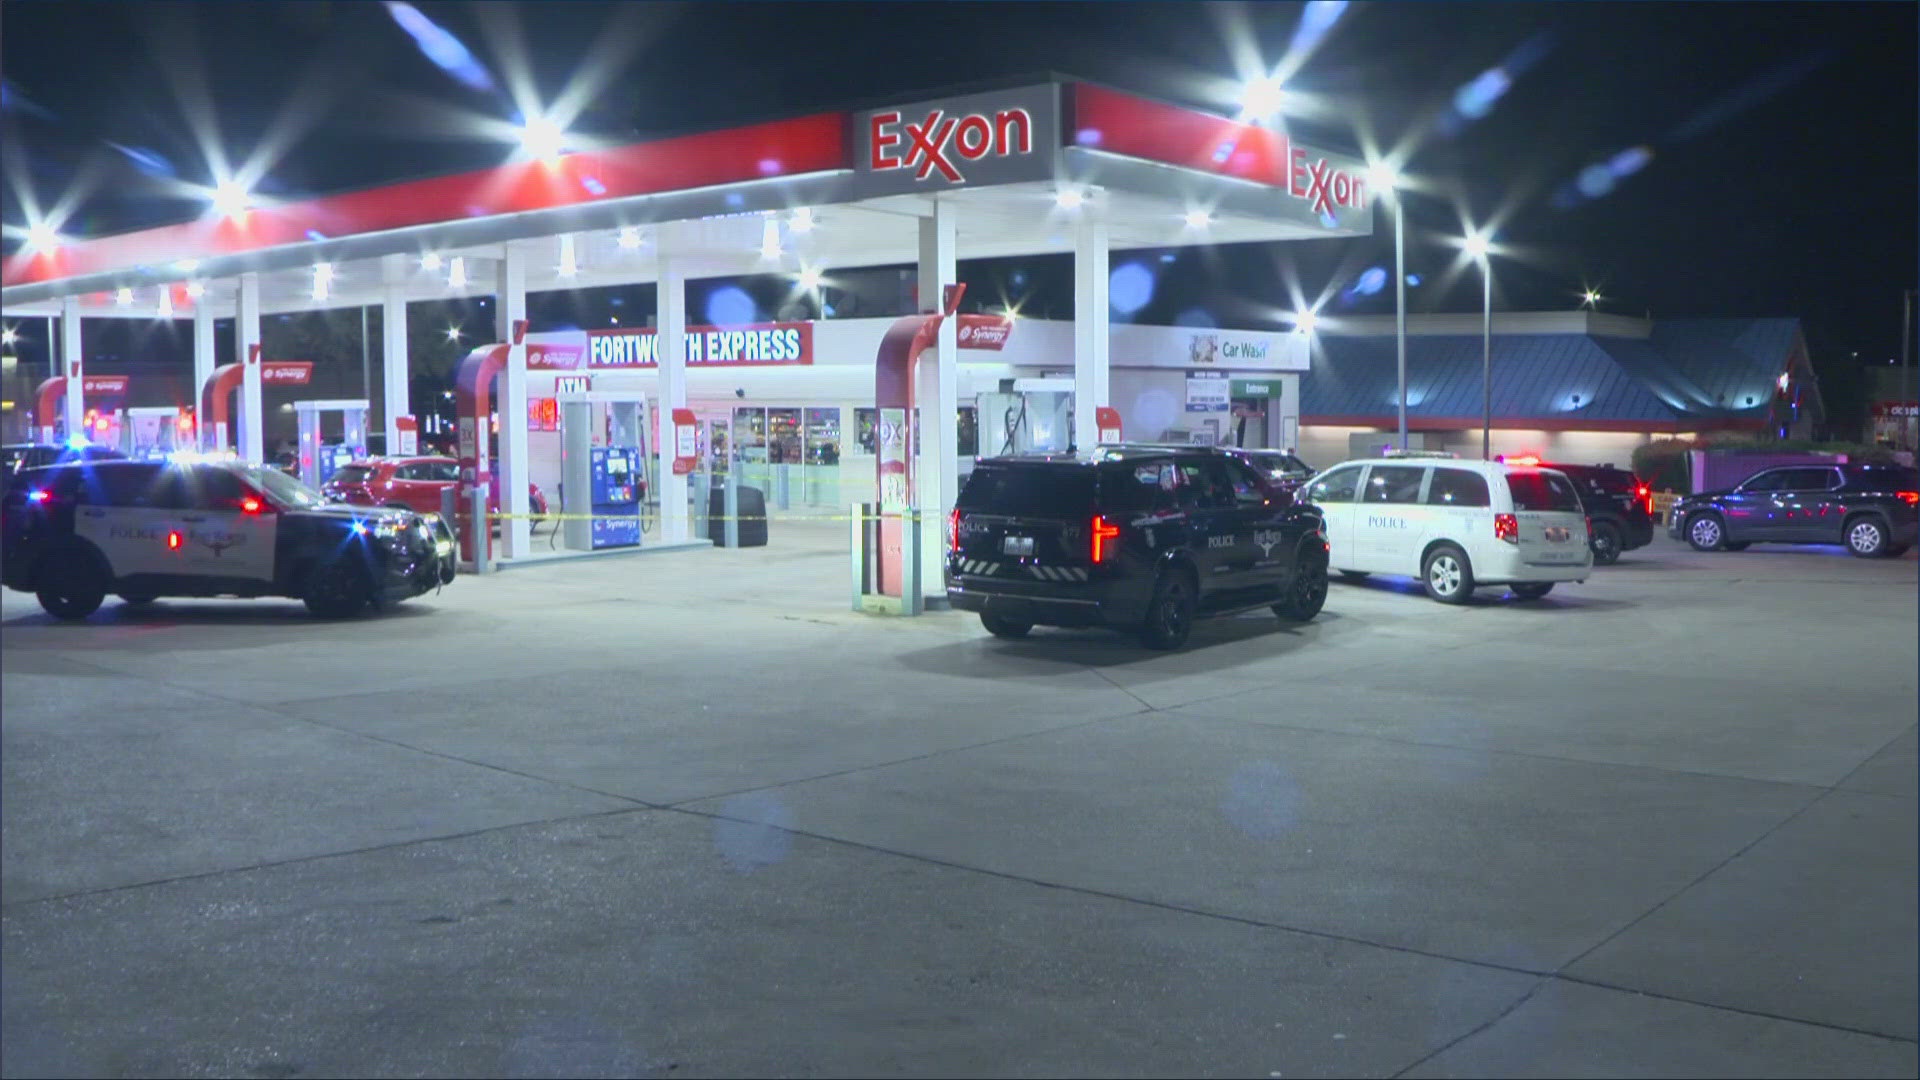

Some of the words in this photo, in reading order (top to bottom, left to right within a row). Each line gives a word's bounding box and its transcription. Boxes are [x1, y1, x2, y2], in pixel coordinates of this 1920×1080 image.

[870, 108, 1032, 184] Exxon
[1288, 148, 1366, 220] Exxon
[972, 328, 1006, 343] Synergy
[706, 329, 800, 361] EXPRESS
[1222, 342, 1239, 357] Car
[1241, 342, 1266, 359] Wash
[557, 377, 587, 393] ATM
[606, 519, 637, 531] Synergy
[1368, 515, 1408, 529] POLICE
[1208, 534, 1235, 548] POLICE
